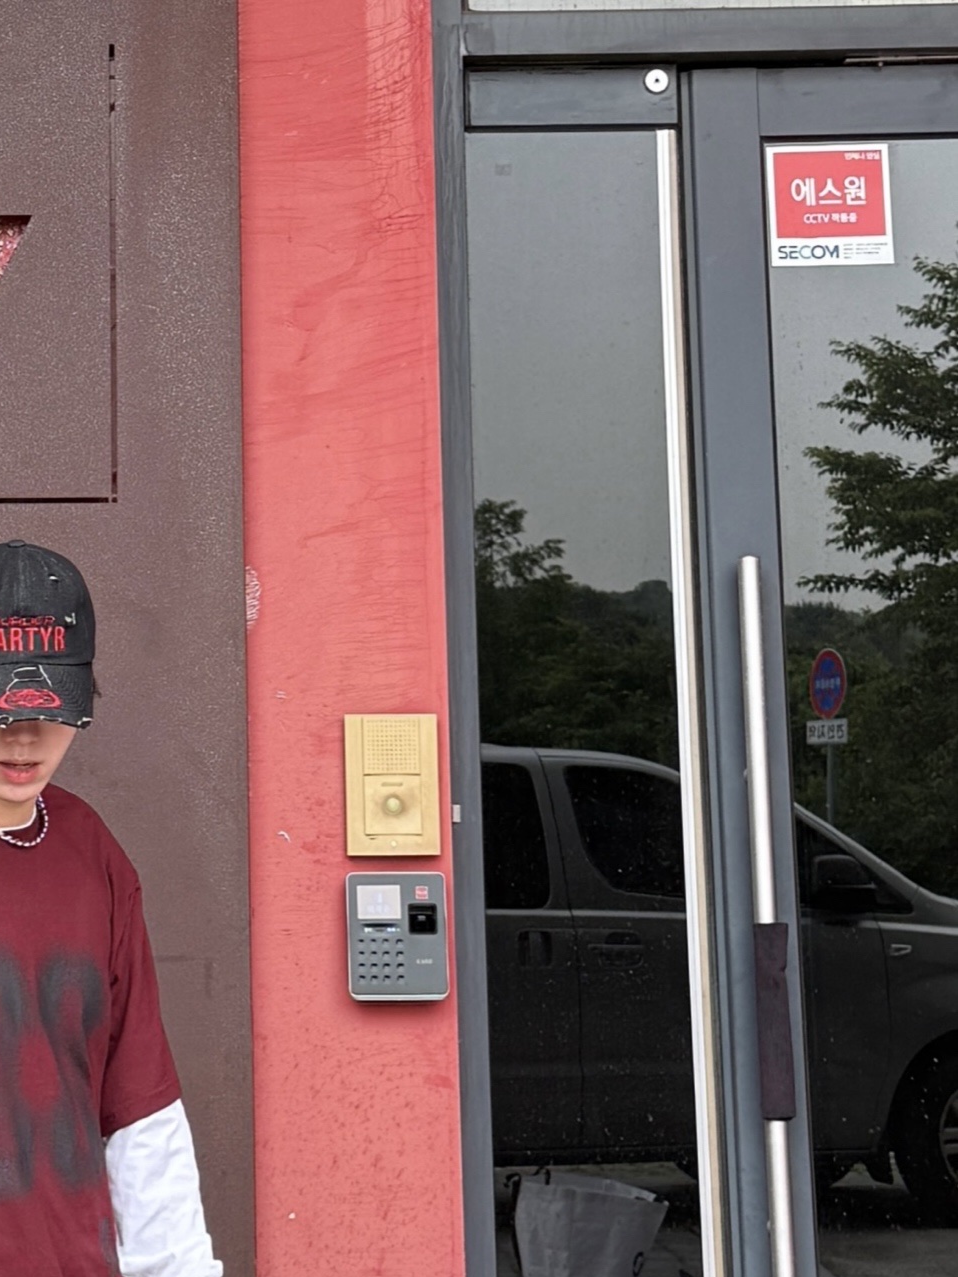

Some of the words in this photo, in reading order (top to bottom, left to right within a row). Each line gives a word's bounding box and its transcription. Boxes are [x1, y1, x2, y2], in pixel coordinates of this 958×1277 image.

[790, 176, 867, 206] 에스원
[803, 213, 830, 224] CCTV
[778, 244, 840, 260] SECOM
